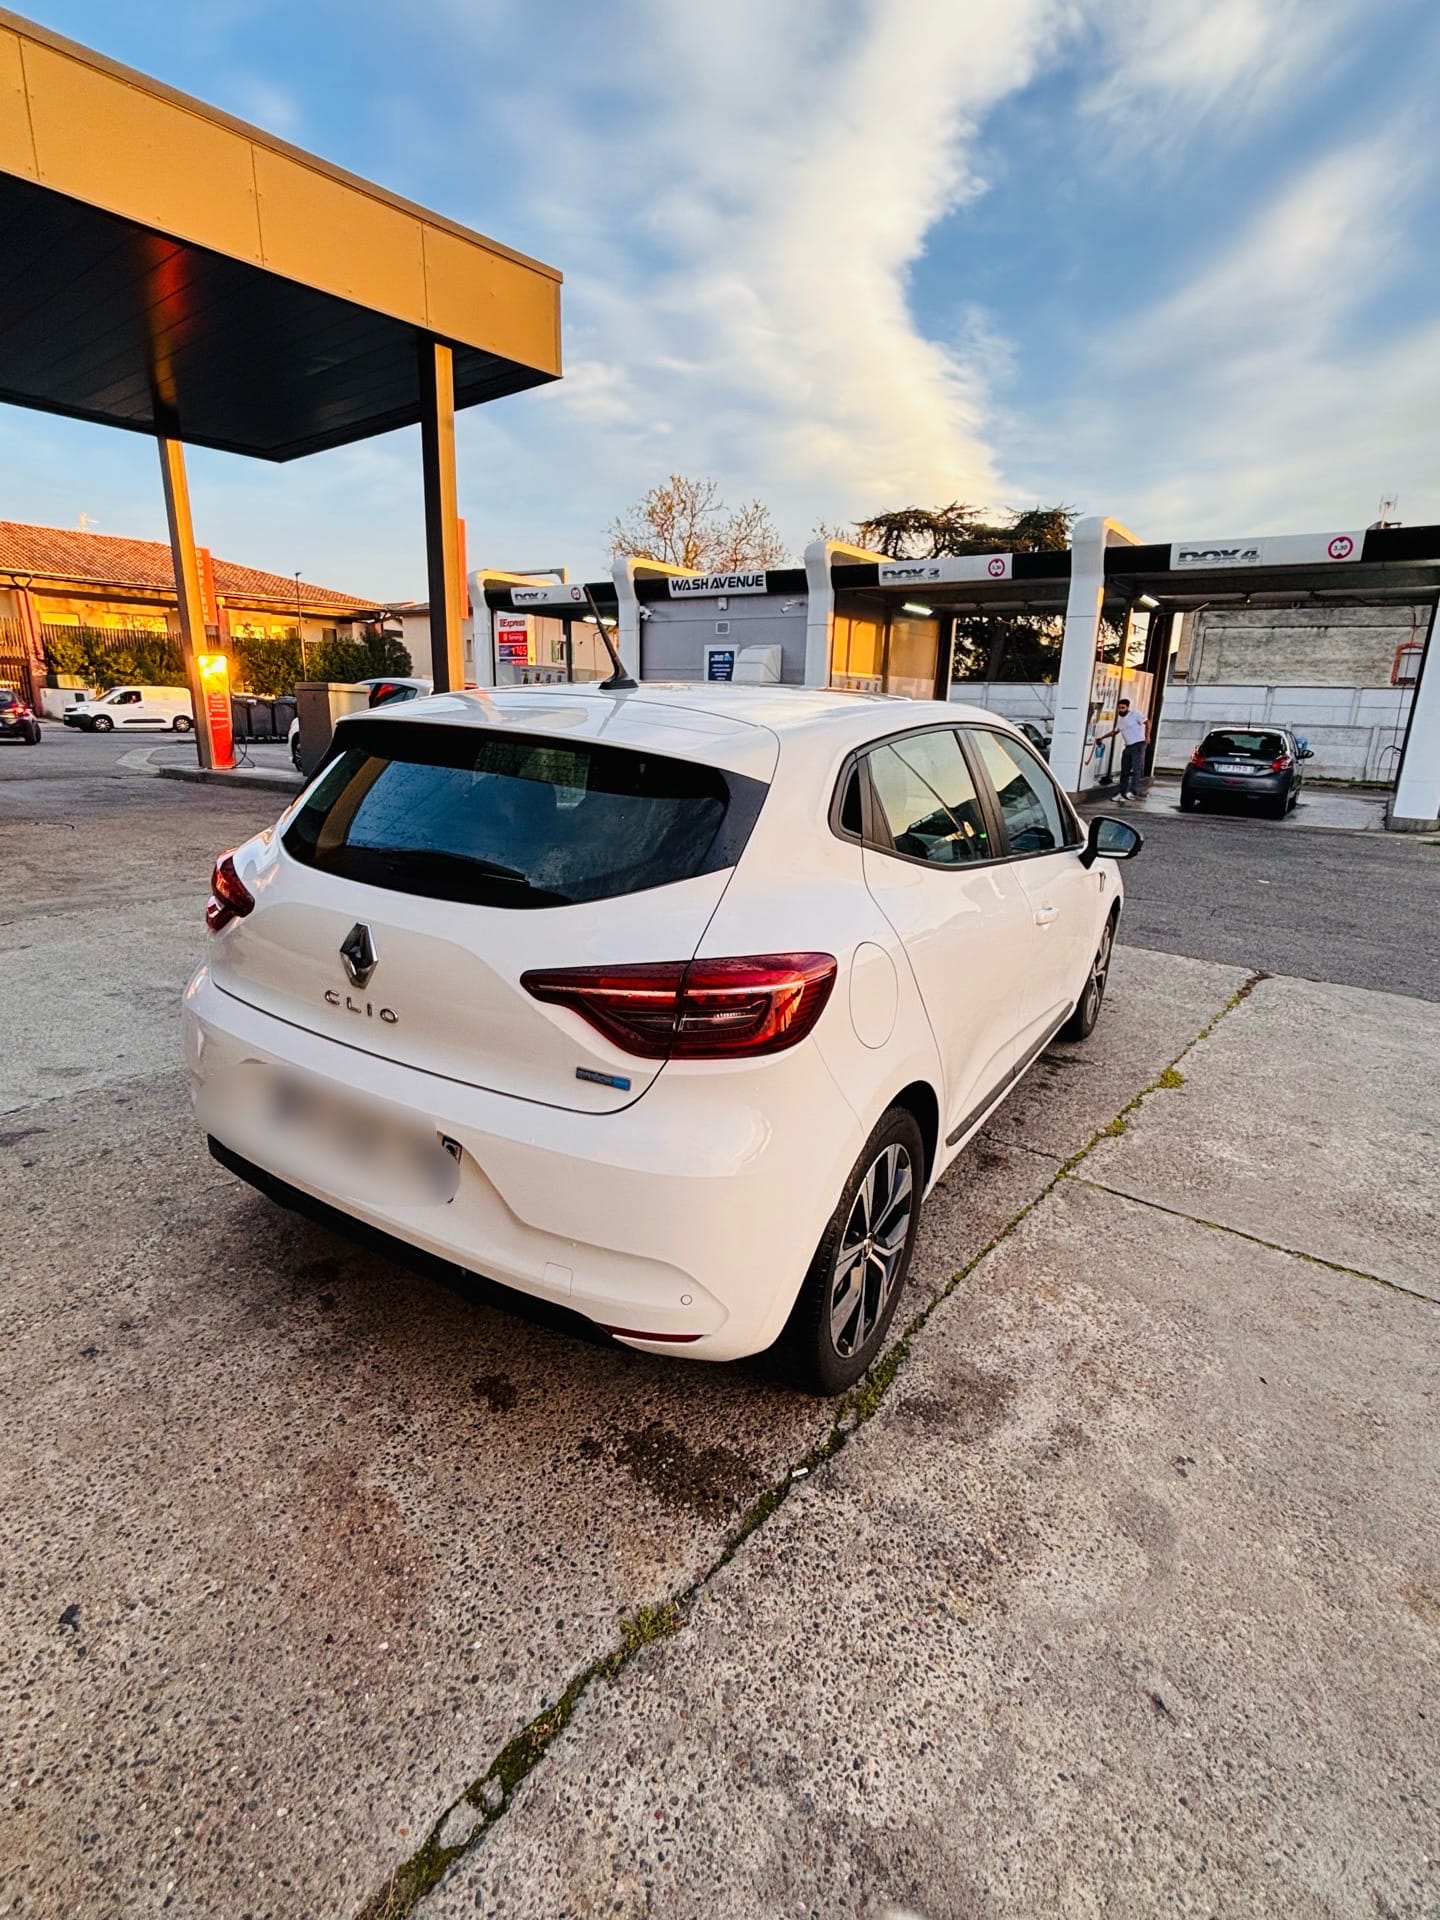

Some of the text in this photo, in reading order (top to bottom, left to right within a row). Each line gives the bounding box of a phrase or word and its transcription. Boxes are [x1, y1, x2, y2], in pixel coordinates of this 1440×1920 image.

[671, 575, 764, 591] WASH AVENUE
[324, 989, 399, 1024] CLIO
